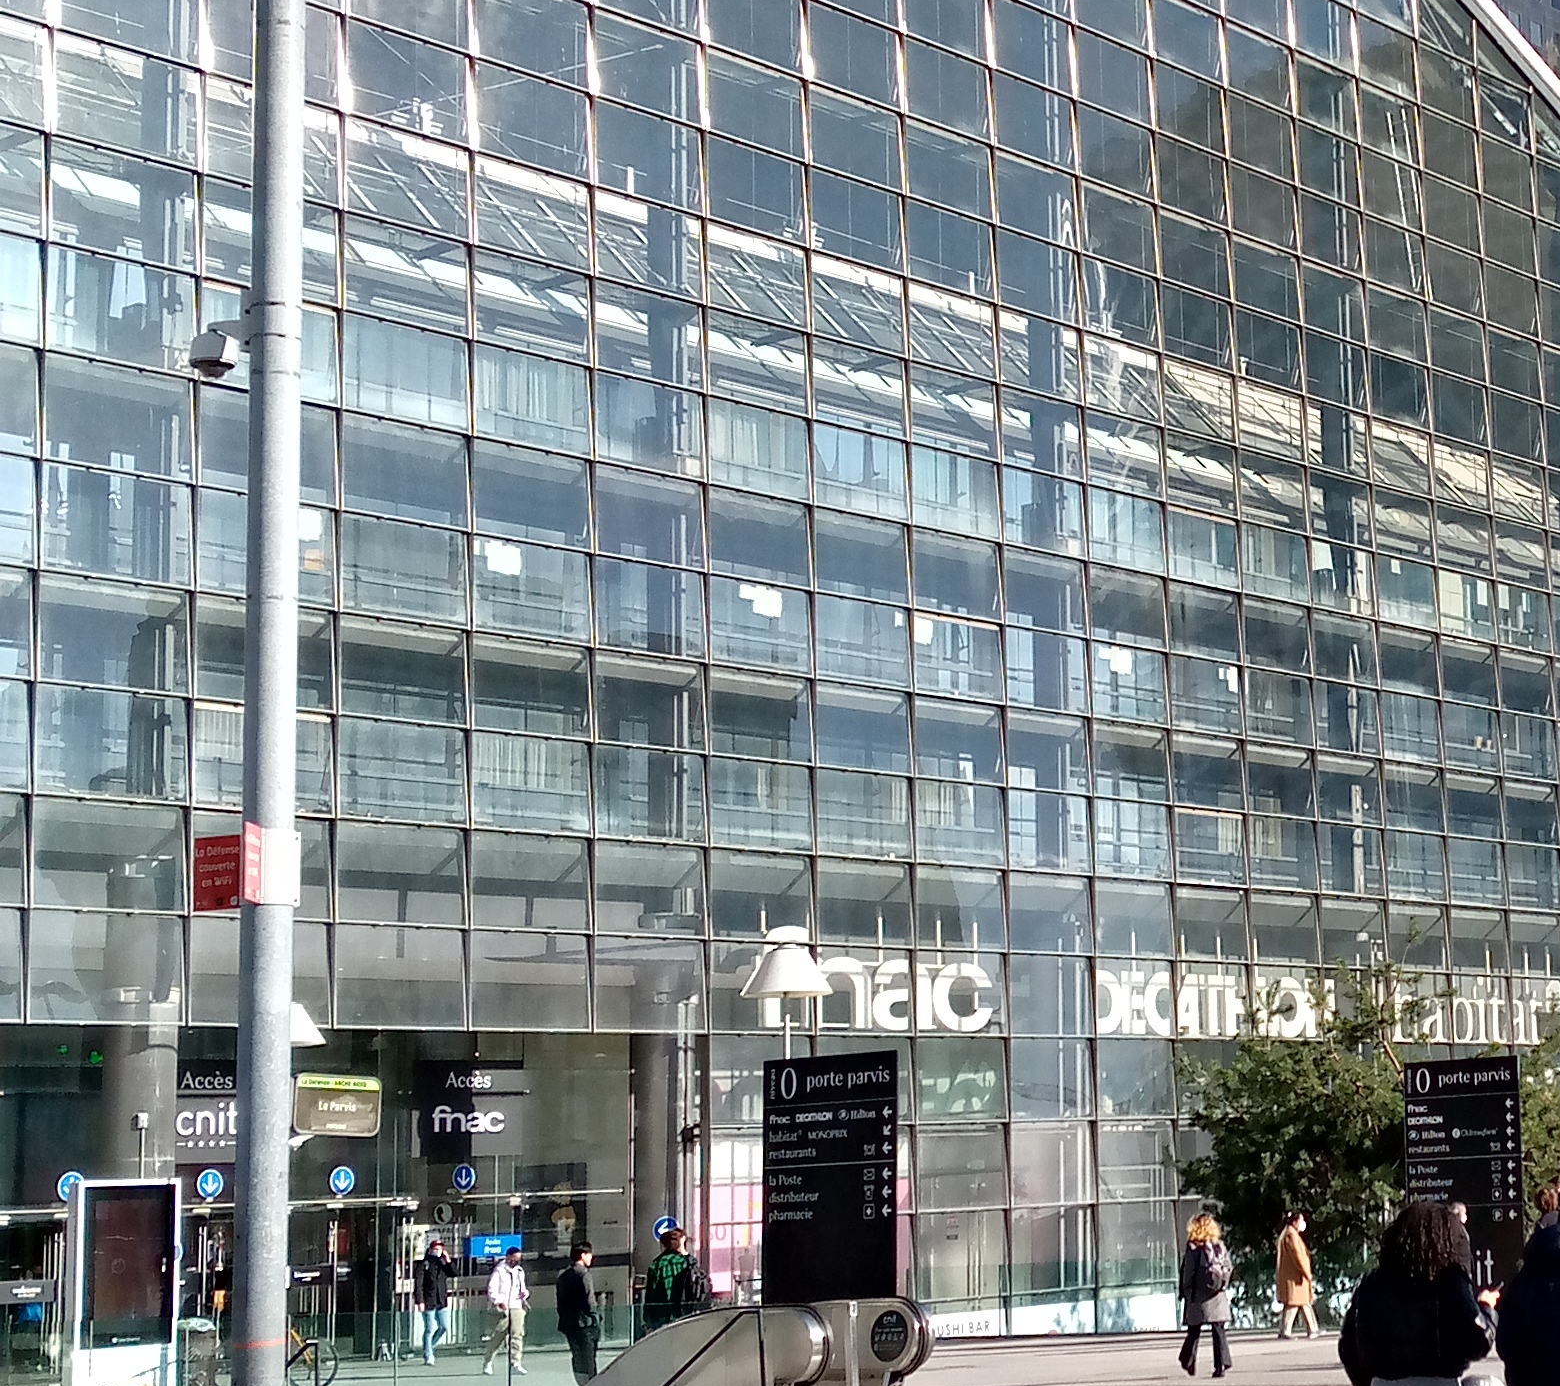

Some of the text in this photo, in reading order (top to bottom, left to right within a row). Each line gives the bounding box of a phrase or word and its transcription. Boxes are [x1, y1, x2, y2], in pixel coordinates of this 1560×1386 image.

[199, 862, 236, 872] couverte
[201, 879, 212, 888] en
[181, 1071, 233, 1089] Accès
[446, 1070, 492, 1089] Accès
[806, 1071, 844, 1093] porte
[847, 1065, 890, 1089] parvis
[1438, 1071, 1471, 1088] porte
[1474, 1066, 1511, 1086] parvis
[318, 1100, 356, 1112] Le Parvis
[1407, 1104, 1428, 1113] fnac
[176, 1101, 237, 1136] cnit
[432, 1105, 505, 1133] fnac
[769, 1108, 876, 1125] fnac DECATHLON Hilton
[808, 1128, 848, 1140] MONOPRIX
[768, 1147, 816, 1160] restaurants
[1408, 1144, 1450, 1154] restaurants
[1417, 1165, 1439, 1175] Poste
[778, 1174, 802, 1186] Poste
[1409, 1177, 1454, 1188] distributeur
[768, 1191, 819, 1204] distributeur
[768, 1207, 814, 1223] pharmacie
[937, 1320, 990, 1336] USHI BAR
